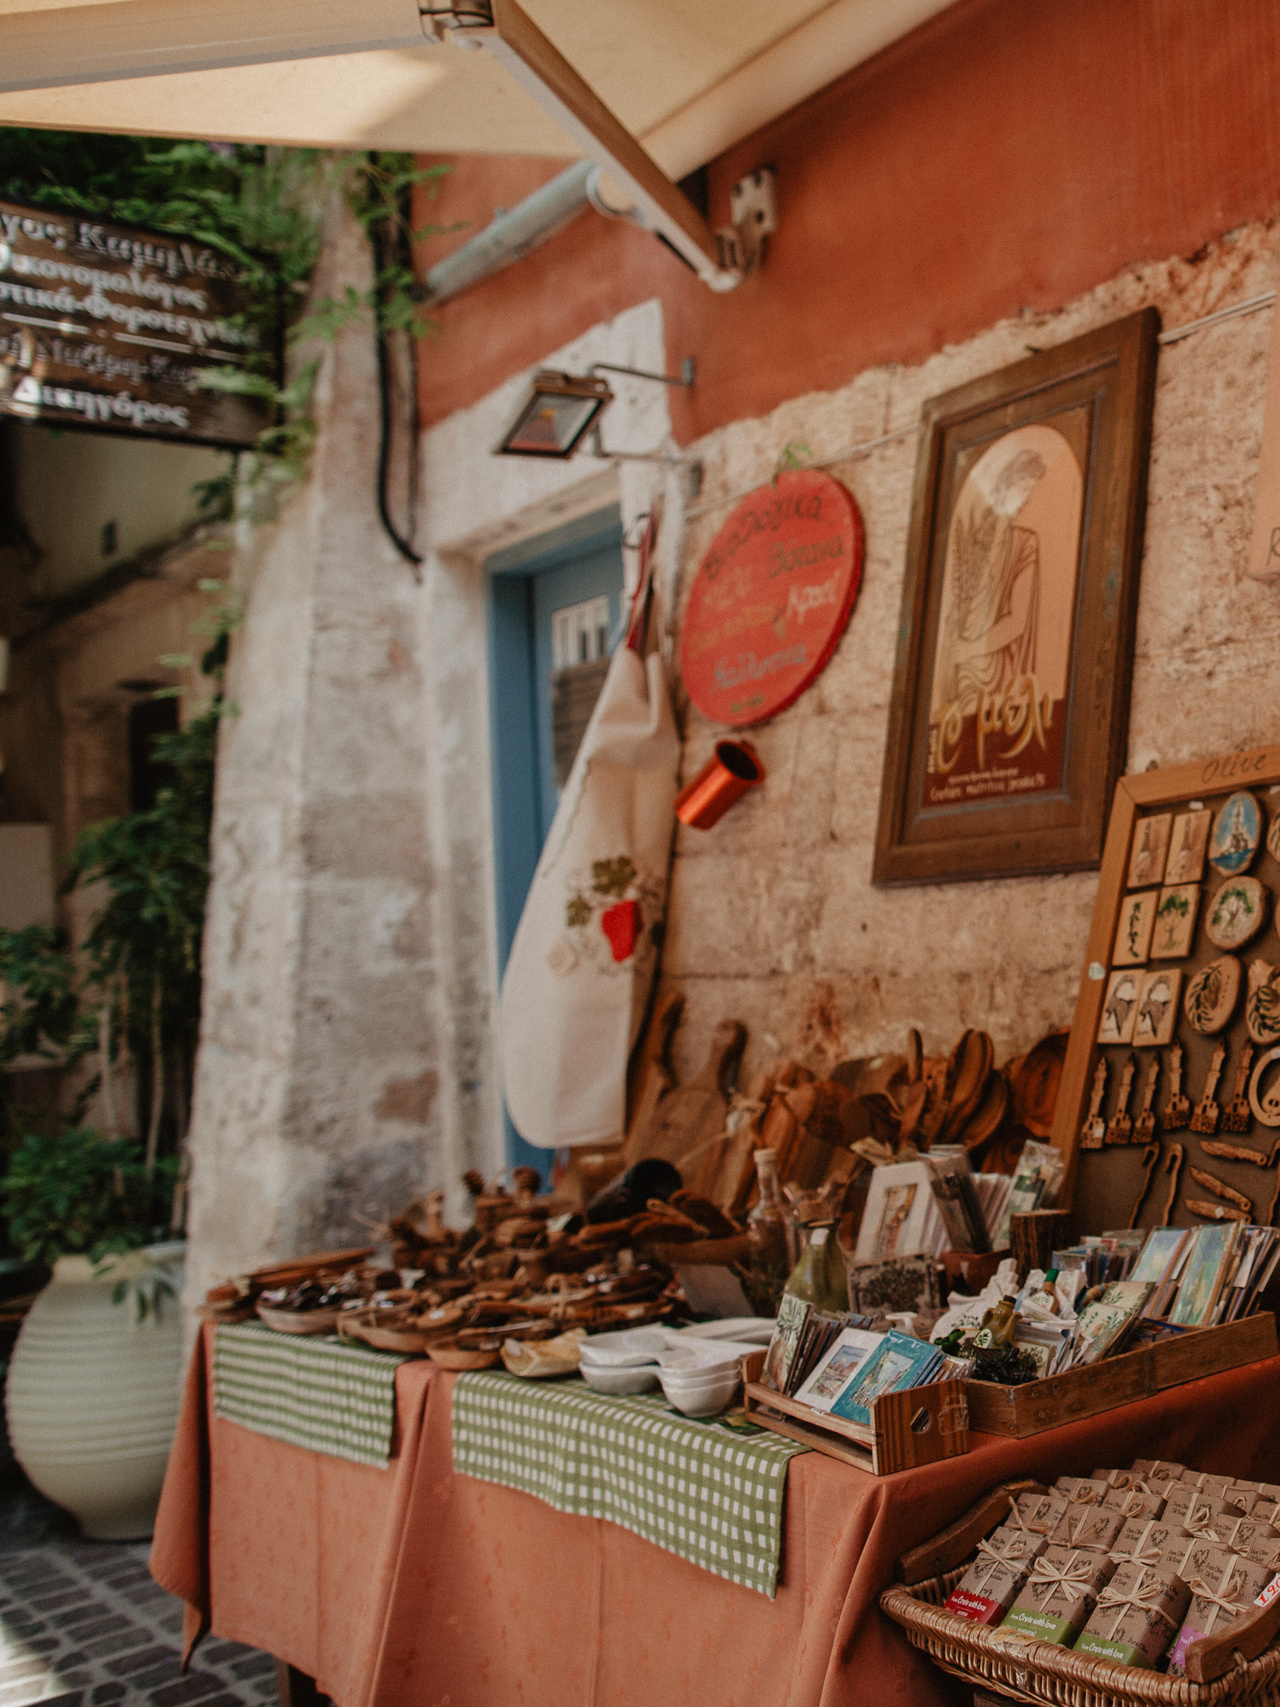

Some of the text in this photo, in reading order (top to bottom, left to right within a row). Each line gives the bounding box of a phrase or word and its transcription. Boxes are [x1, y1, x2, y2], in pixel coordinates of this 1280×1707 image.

[958, 1595, 969, 1606] Crete
[969, 1599, 979, 1609] with
[979, 1602, 987, 1611] love
[1010, 1612, 1057, 1631] From Crete with love
[1081, 1642, 1124, 1660] From Crete with love
